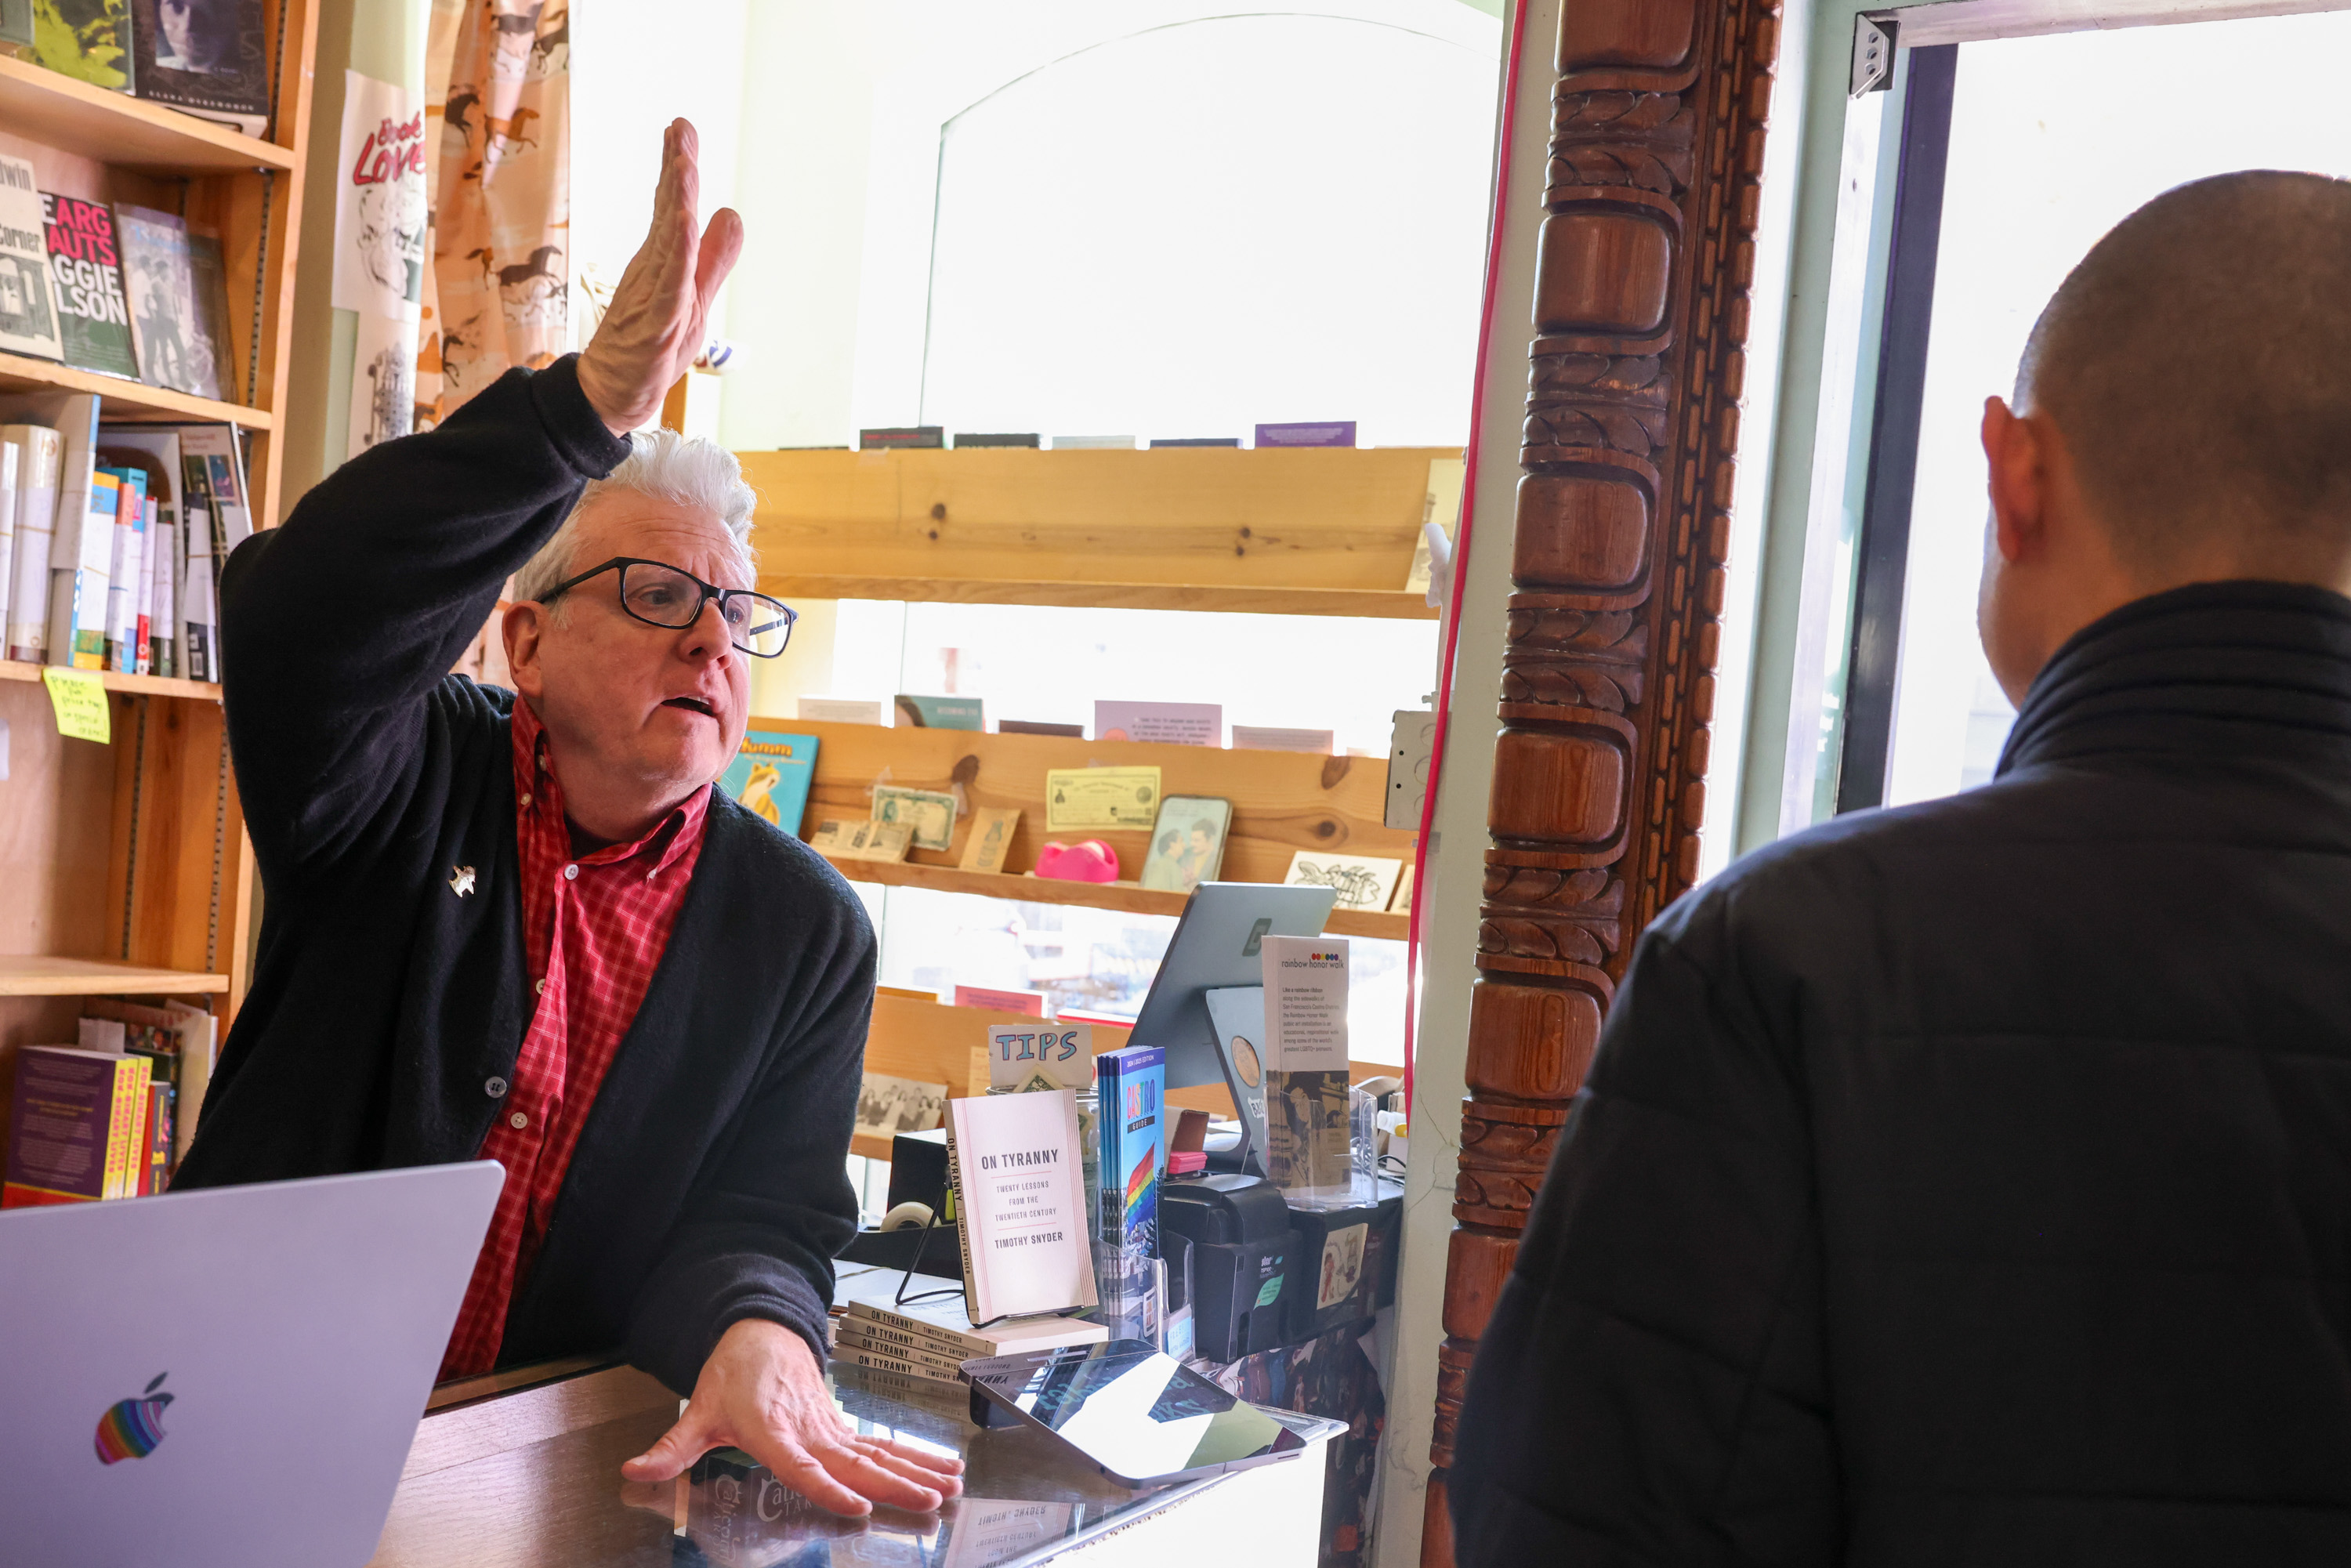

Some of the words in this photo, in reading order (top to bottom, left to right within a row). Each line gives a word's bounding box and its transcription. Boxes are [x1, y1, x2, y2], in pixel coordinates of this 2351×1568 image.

[377, 110, 422, 147] Book
[40, 193, 57, 226] E
[56, 197, 111, 237] ARG
[48, 225, 118, 266] AUTS
[49, 254, 122, 298] GGIE
[53, 281, 128, 326] LSON
[1281, 959, 1308, 969] rainbow
[1309, 959, 1328, 969] honor
[1329, 959, 1344, 969] walk
[995, 1031, 1078, 1061] TIPS
[1143, 1054, 1154, 1063] EDITION
[1127, 1079, 1155, 1120] CASTRO
[1132, 1118, 1147, 1130] GUIDE
[947, 1138, 955, 1151] ON
[981, 1156, 998, 1170] ON
[1002, 1149, 1059, 1168] TYRANNY
[949, 1155, 962, 1201] TYRANNY
[996, 1183, 1020, 1193] TWENTY
[1022, 1181, 1049, 1191] LESSONS
[995, 1211, 1028, 1222] TWENTIETH
[1029, 1208, 1057, 1219] CENTURY
[1009, 1197, 1025, 1206] FROM
[1027, 1196, 1038, 1204] THE
[994, 1237, 1028, 1249] TIMOTHY
[1031, 1232, 1063, 1244] SNYDER
[962, 1249, 971, 1274] SNYDER
[871, 1310, 880, 1320] ON
[882, 1313, 914, 1331] TYRANNY
[923, 1327, 943, 1338] TIMOTHY
[944, 1333, 962, 1344] SNYDER
[862, 1338, 871, 1348] ON
[874, 1341, 909, 1359] TYRANNY
[920, 1354, 942, 1366] TIMOTHY
[943, 1361, 960, 1371] SNYDE
[866, 1325, 875, 1335] ON
[877, 1328, 914, 1345] TYRANNY
[925, 1342, 947, 1353] TIMOTHY
[948, 1348, 969, 1359] SNYDER
[859, 1355, 870, 1365] ON
[873, 1357, 912, 1374] TYRANNY
[926, 1369, 951, 1382] TIMOTHY
